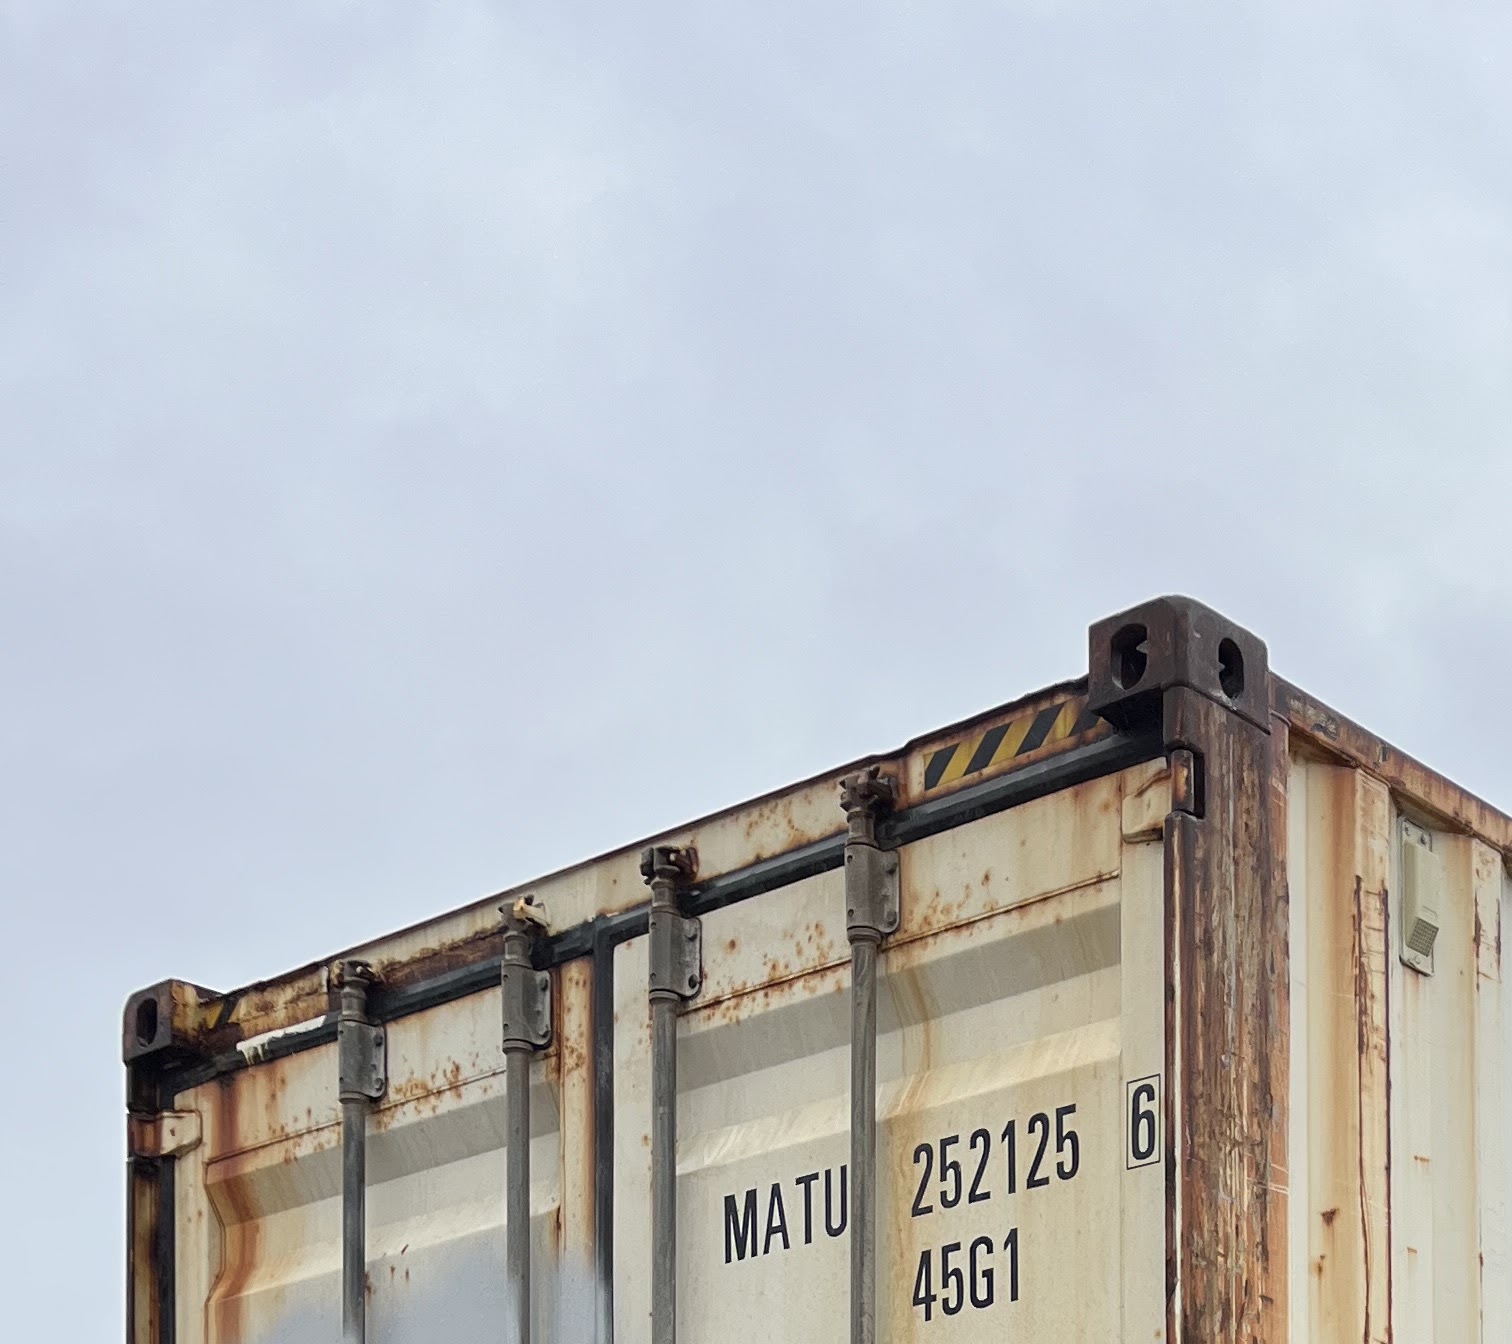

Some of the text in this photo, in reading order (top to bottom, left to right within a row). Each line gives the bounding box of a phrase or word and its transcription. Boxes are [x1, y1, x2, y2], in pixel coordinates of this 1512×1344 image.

[724, 1083, 1156, 1264] MATU 252125 6
[912, 1228, 1019, 1321] 45G1
